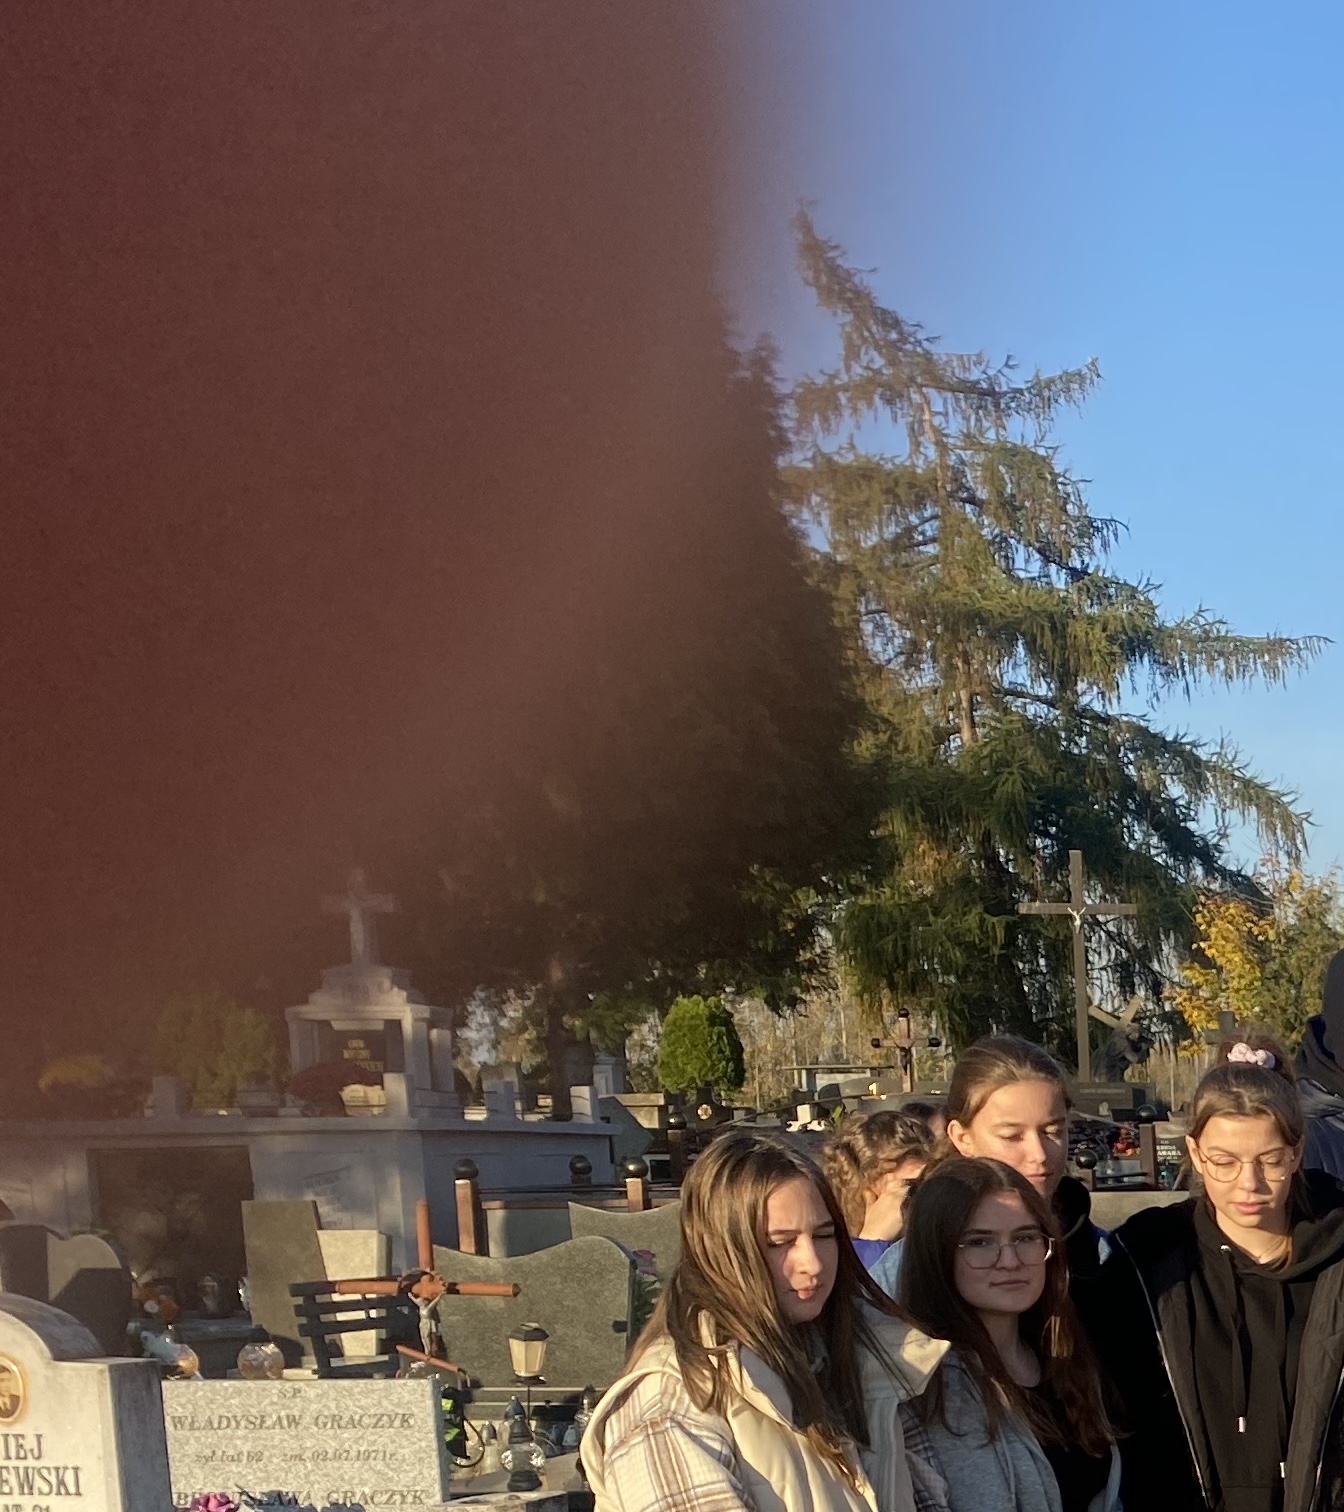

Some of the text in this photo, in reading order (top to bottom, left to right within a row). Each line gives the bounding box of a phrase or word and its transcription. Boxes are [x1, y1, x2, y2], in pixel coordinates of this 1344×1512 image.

[170, 1412, 416, 1432] WŁADYSŁAW GRACZYK
[0, 1432, 44, 1461] IEJ
[0, 1465, 83, 1497] EWSKI
[326, 1489, 427, 1507] GRACZYK
